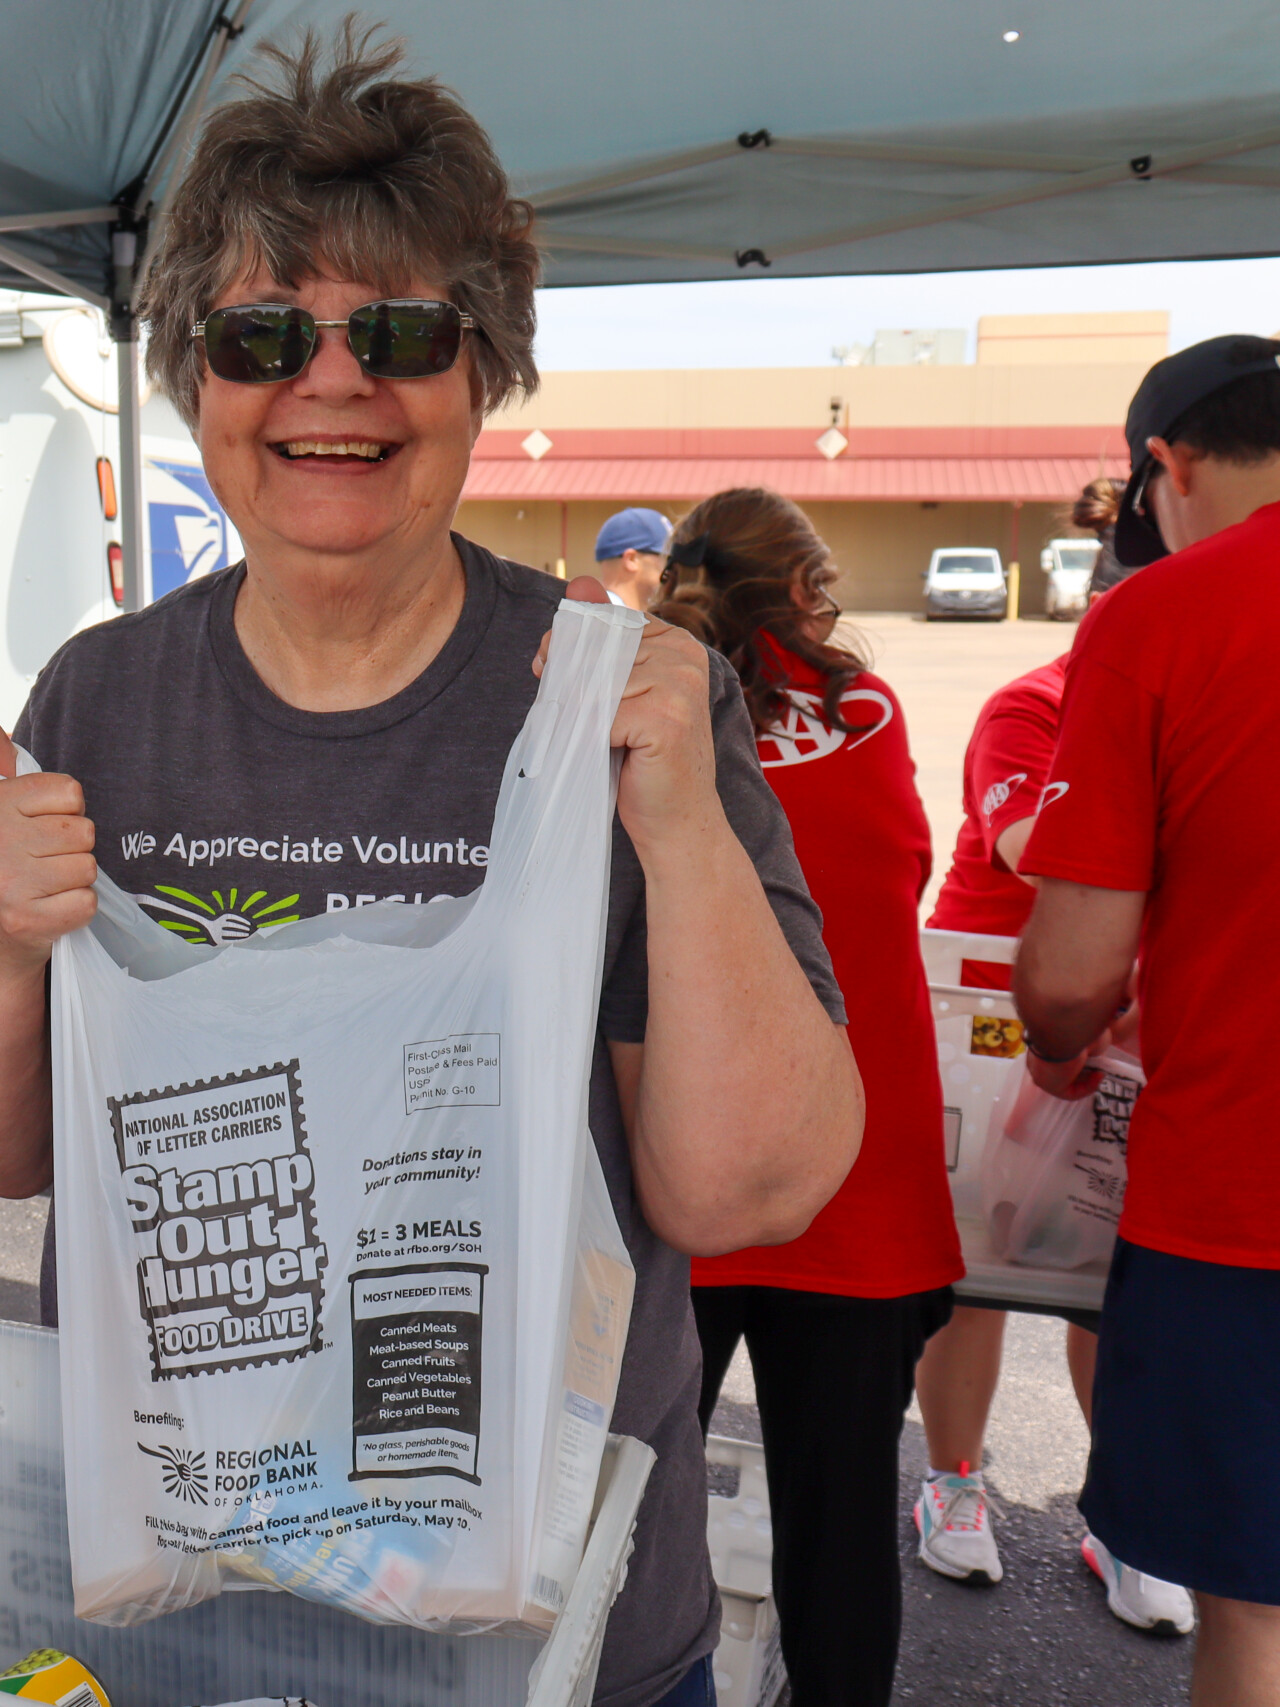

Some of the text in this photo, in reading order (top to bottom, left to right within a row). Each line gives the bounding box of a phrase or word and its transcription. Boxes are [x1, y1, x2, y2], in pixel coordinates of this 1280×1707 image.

[121, 831, 156, 861] We
[163, 832, 344, 866] Appreciate
[454, 1044, 472, 1054] Mail
[443, 1060, 450, 1068] &
[452, 1058, 474, 1067] Fees
[477, 1057, 498, 1067] Paid
[452, 1085, 476, 1095] G-10
[125, 1091, 287, 1139] NATIONAL ASSOCIATION
[137, 1114, 282, 1157] OF LETTER CARRIERS
[431, 1147, 464, 1162] stay
[467, 1146, 482, 1159] in
[394, 1166, 481, 1185] community!
[121, 1153, 315, 1222] Stamp
[357, 1228, 377, 1249] $1
[395, 1224, 407, 1241] 3
[413, 1220, 482, 1239] MEALS
[356, 1242, 482, 1262] Donate at rfbo.org/SOH
[139, 1243, 327, 1308] Hunger
[363, 1291, 394, 1303] MOST
[395, 1287, 436, 1299] NEEDED
[155, 1307, 308, 1356] FOOD DRIVE
[380, 1322, 457, 1337] Canned Meats
[369, 1339, 469, 1356] Meat-based Soups
[381, 1355, 456, 1369] Canned Fruits
[367, 1371, 472, 1388] Canned Vegetables
[382, 1388, 457, 1403] Peanut Butter
[134, 1409, 185, 1431] Benefiting:
[379, 1404, 460, 1420] Rice and Beans
[378, 1440, 404, 1452] glass,
[405, 1437, 450, 1449] perishable
[450, 1439, 470, 1452] goods
[216, 1440, 317, 1469] REGIONAL
[377, 1454, 387, 1462] or
[388, 1450, 437, 1461] homemade
[215, 1461, 318, 1492] FOOD BANK
[214, 1498, 228, 1507] OF
[146, 1515, 159, 1529] Fill
[190, 1526, 207, 1540] with
[209, 1519, 263, 1541] canned
[267, 1515, 299, 1530] food
[304, 1508, 328, 1524] and
[332, 1501, 368, 1518] leave
[372, 1497, 381, 1509] it
[385, 1497, 401, 1510] by
[405, 1498, 437, 1511] your
[441, 1498, 482, 1520] mailbox
[214, 1537, 262, 1550] carrier
[264, 1535, 279, 1544] to
[282, 1527, 311, 1545] pick
[336, 1523, 352, 1535] on
[355, 1513, 421, 1530] Saturday,
[425, 1515, 454, 1528] May
